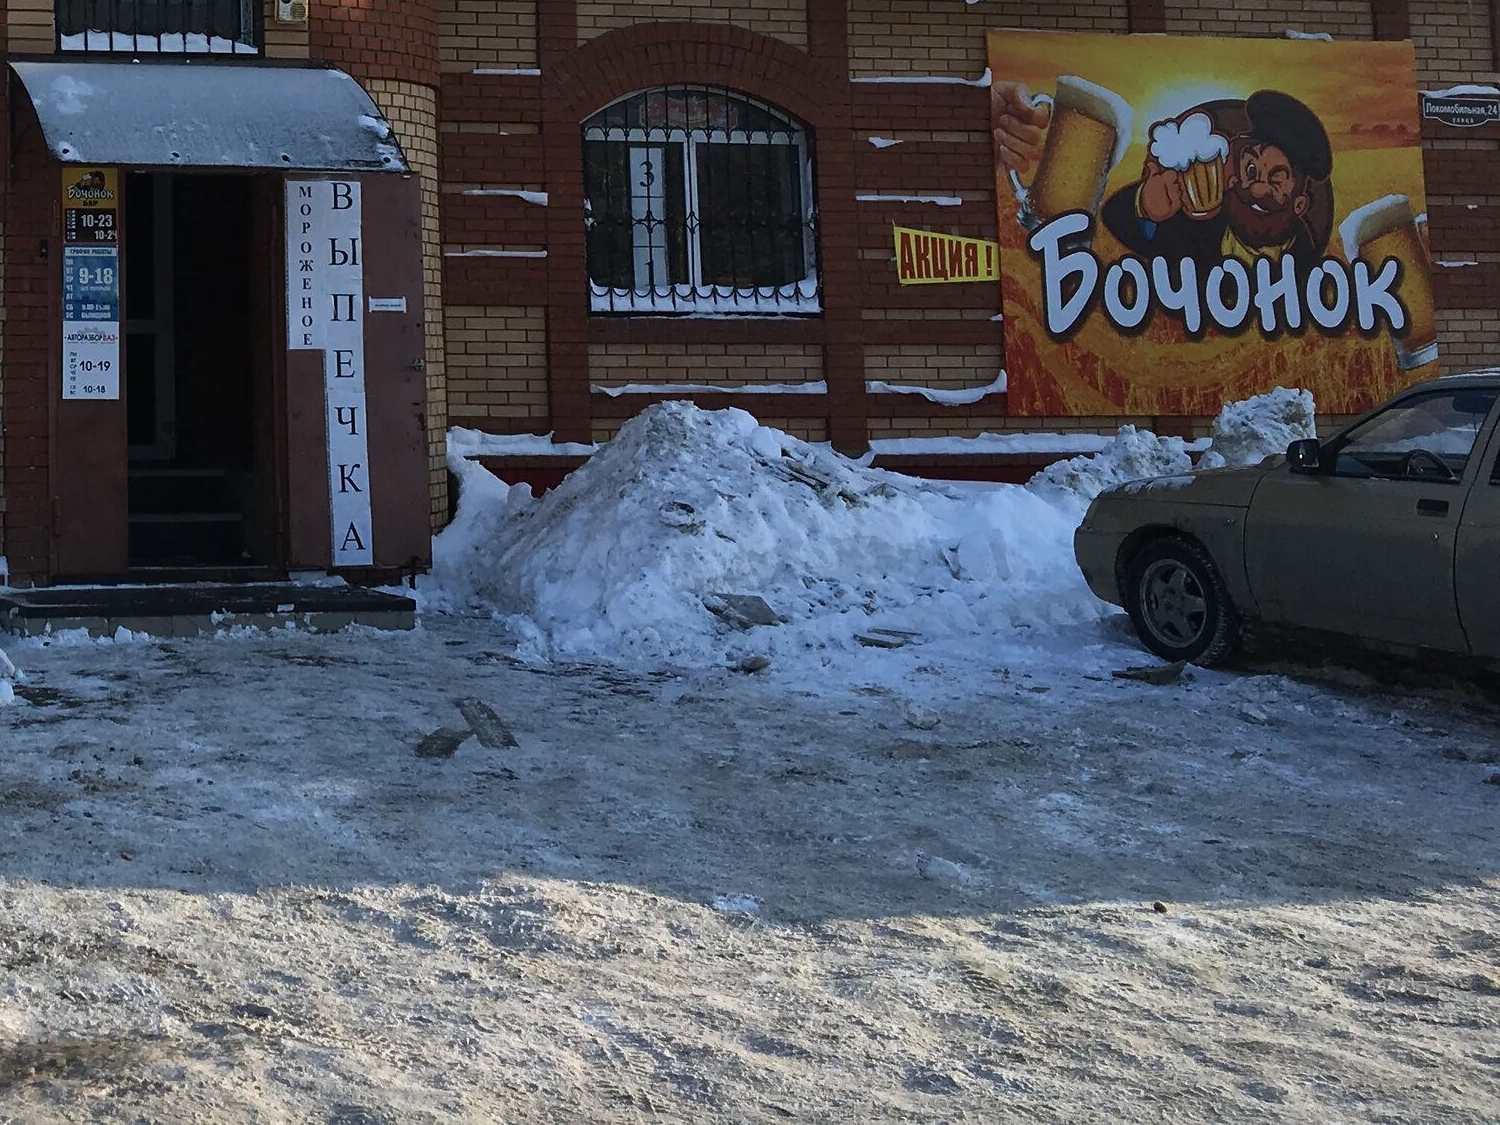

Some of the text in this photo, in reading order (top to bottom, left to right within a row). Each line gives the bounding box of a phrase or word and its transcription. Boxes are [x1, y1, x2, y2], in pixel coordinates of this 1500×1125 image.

[68, 184, 114, 199] Бочонок
[81, 214, 113, 227] 10-23
[94, 229, 117, 240] 10-24
[900, 232, 979, 281] АКЦИЯ
[299, 186, 314, 346] МОРОЖЕНОЕ
[1030, 211, 1405, 334] Бочонок
[79, 268, 113, 284] 9-18
[79, 360, 111, 371] 10-19
[328, 181, 366, 551] ВЫПЕЧКА
[83, 385, 106, 393] 10-18
